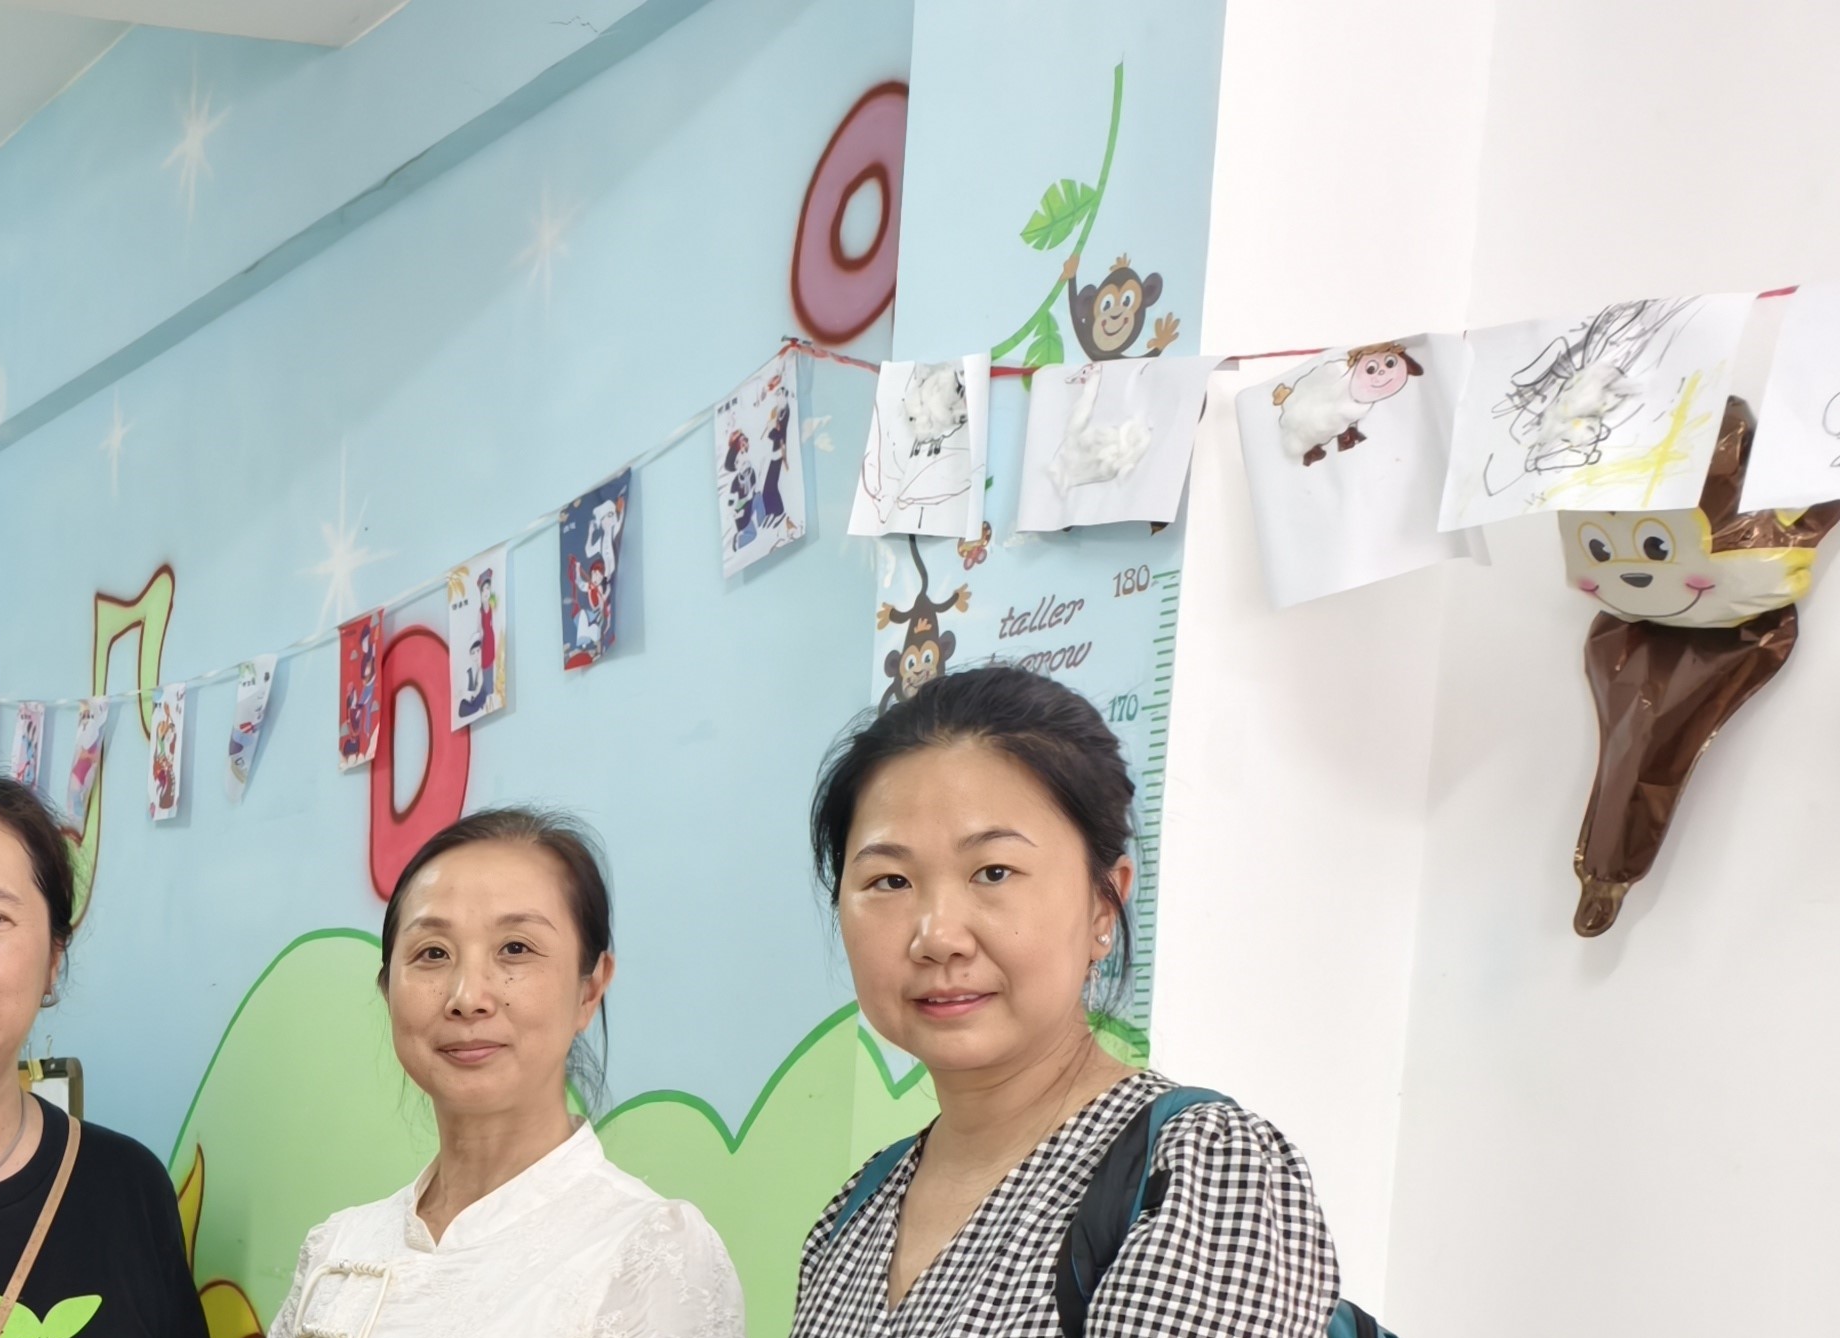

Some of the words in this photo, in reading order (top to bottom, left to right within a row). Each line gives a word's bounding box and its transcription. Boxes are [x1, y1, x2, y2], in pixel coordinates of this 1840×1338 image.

[1112, 564, 1151, 598] 180
[998, 594, 1085, 639] taller
[1108, 694, 1139, 722] 170
